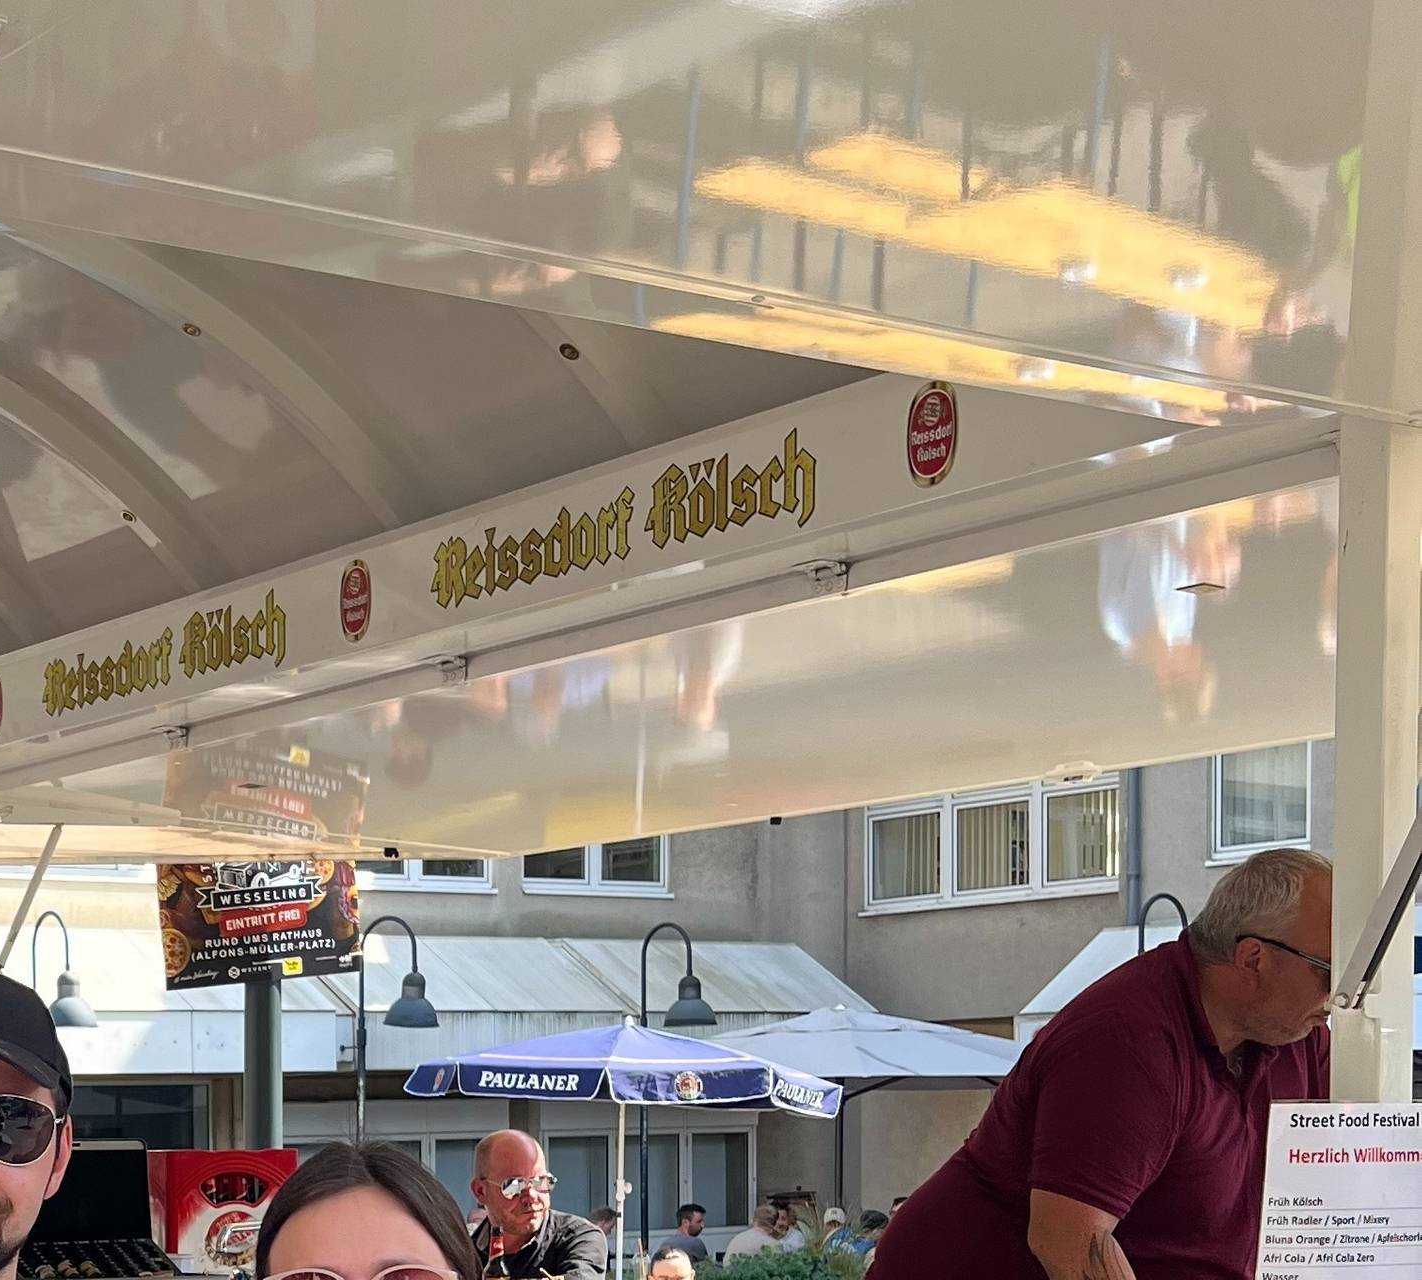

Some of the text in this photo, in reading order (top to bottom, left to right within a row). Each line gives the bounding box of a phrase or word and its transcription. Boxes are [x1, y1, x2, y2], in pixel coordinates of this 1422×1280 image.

[431, 427, 817, 609] Reissdorf Kölsch
[42, 587, 286, 716] Reissdorf Kölsch
[220, 887, 307, 905] WESSELING
[225, 909, 300, 931] EINTRITT FREI
[205, 928, 322, 948] RUND UMS RATHAUS
[191, 939, 335, 961] (ALFONS-MÜLLER-PLATZ)
[479, 1070, 579, 1092] PAULANER
[772, 1079, 825, 1109] PAULANER
[1290, 1112, 1419, 1128] Street Food Festival
[1289, 1148, 1349, 1164] Herzlich
[1268, 1197, 1323, 1206] Früh Kölsch
[1267, 1216, 1288, 1225] Früh
[1291, 1216, 1322, 1225] Radler
[1331, 1216, 1355, 1227] Sport
[1265, 1235, 1293, 1244] Bluna
[1296, 1235, 1330, 1246] Orange
[1340, 1234, 1369, 1244] Zitrone
[1264, 1253, 1282, 1263] Afri
[1284, 1253, 1305, 1263] Cola
[1335, 1253, 1355, 1263] Cola
[1357, 1253, 1374, 1262] Zero
[1262, 1272, 1299, 1280] Wasser
